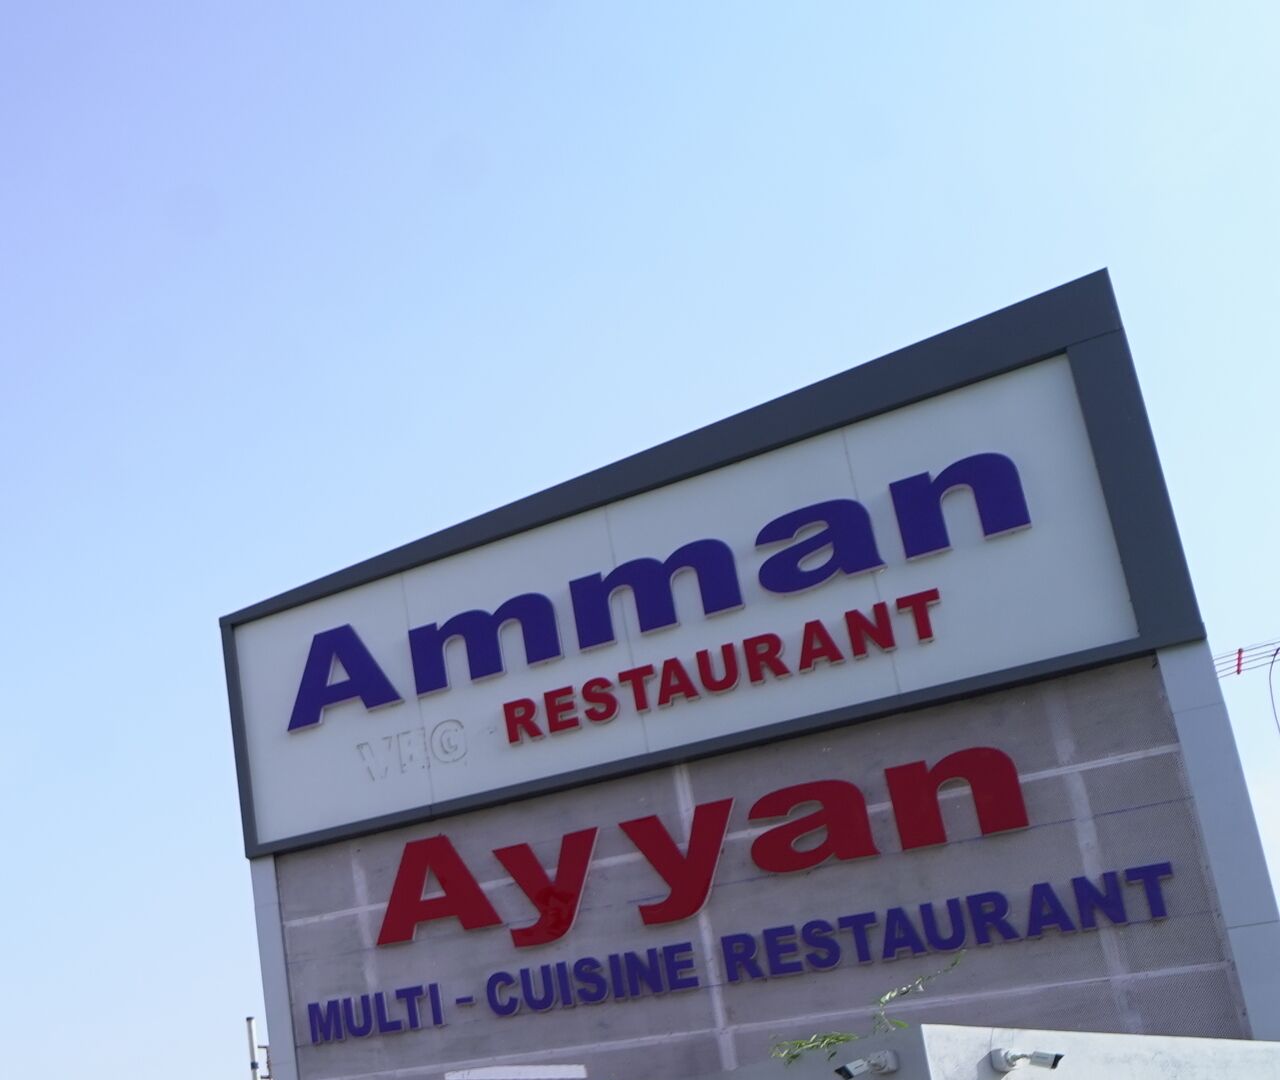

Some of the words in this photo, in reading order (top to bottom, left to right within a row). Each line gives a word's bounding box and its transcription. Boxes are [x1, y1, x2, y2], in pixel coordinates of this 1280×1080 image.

[286, 452, 1032, 732] Amman
[502, 588, 940, 745] RESTAURANT
[376, 746, 1031, 948] Ayyan
[486, 941, 698, 1015] CUISINE
[724, 861, 1174, 982] RESTAURANT
